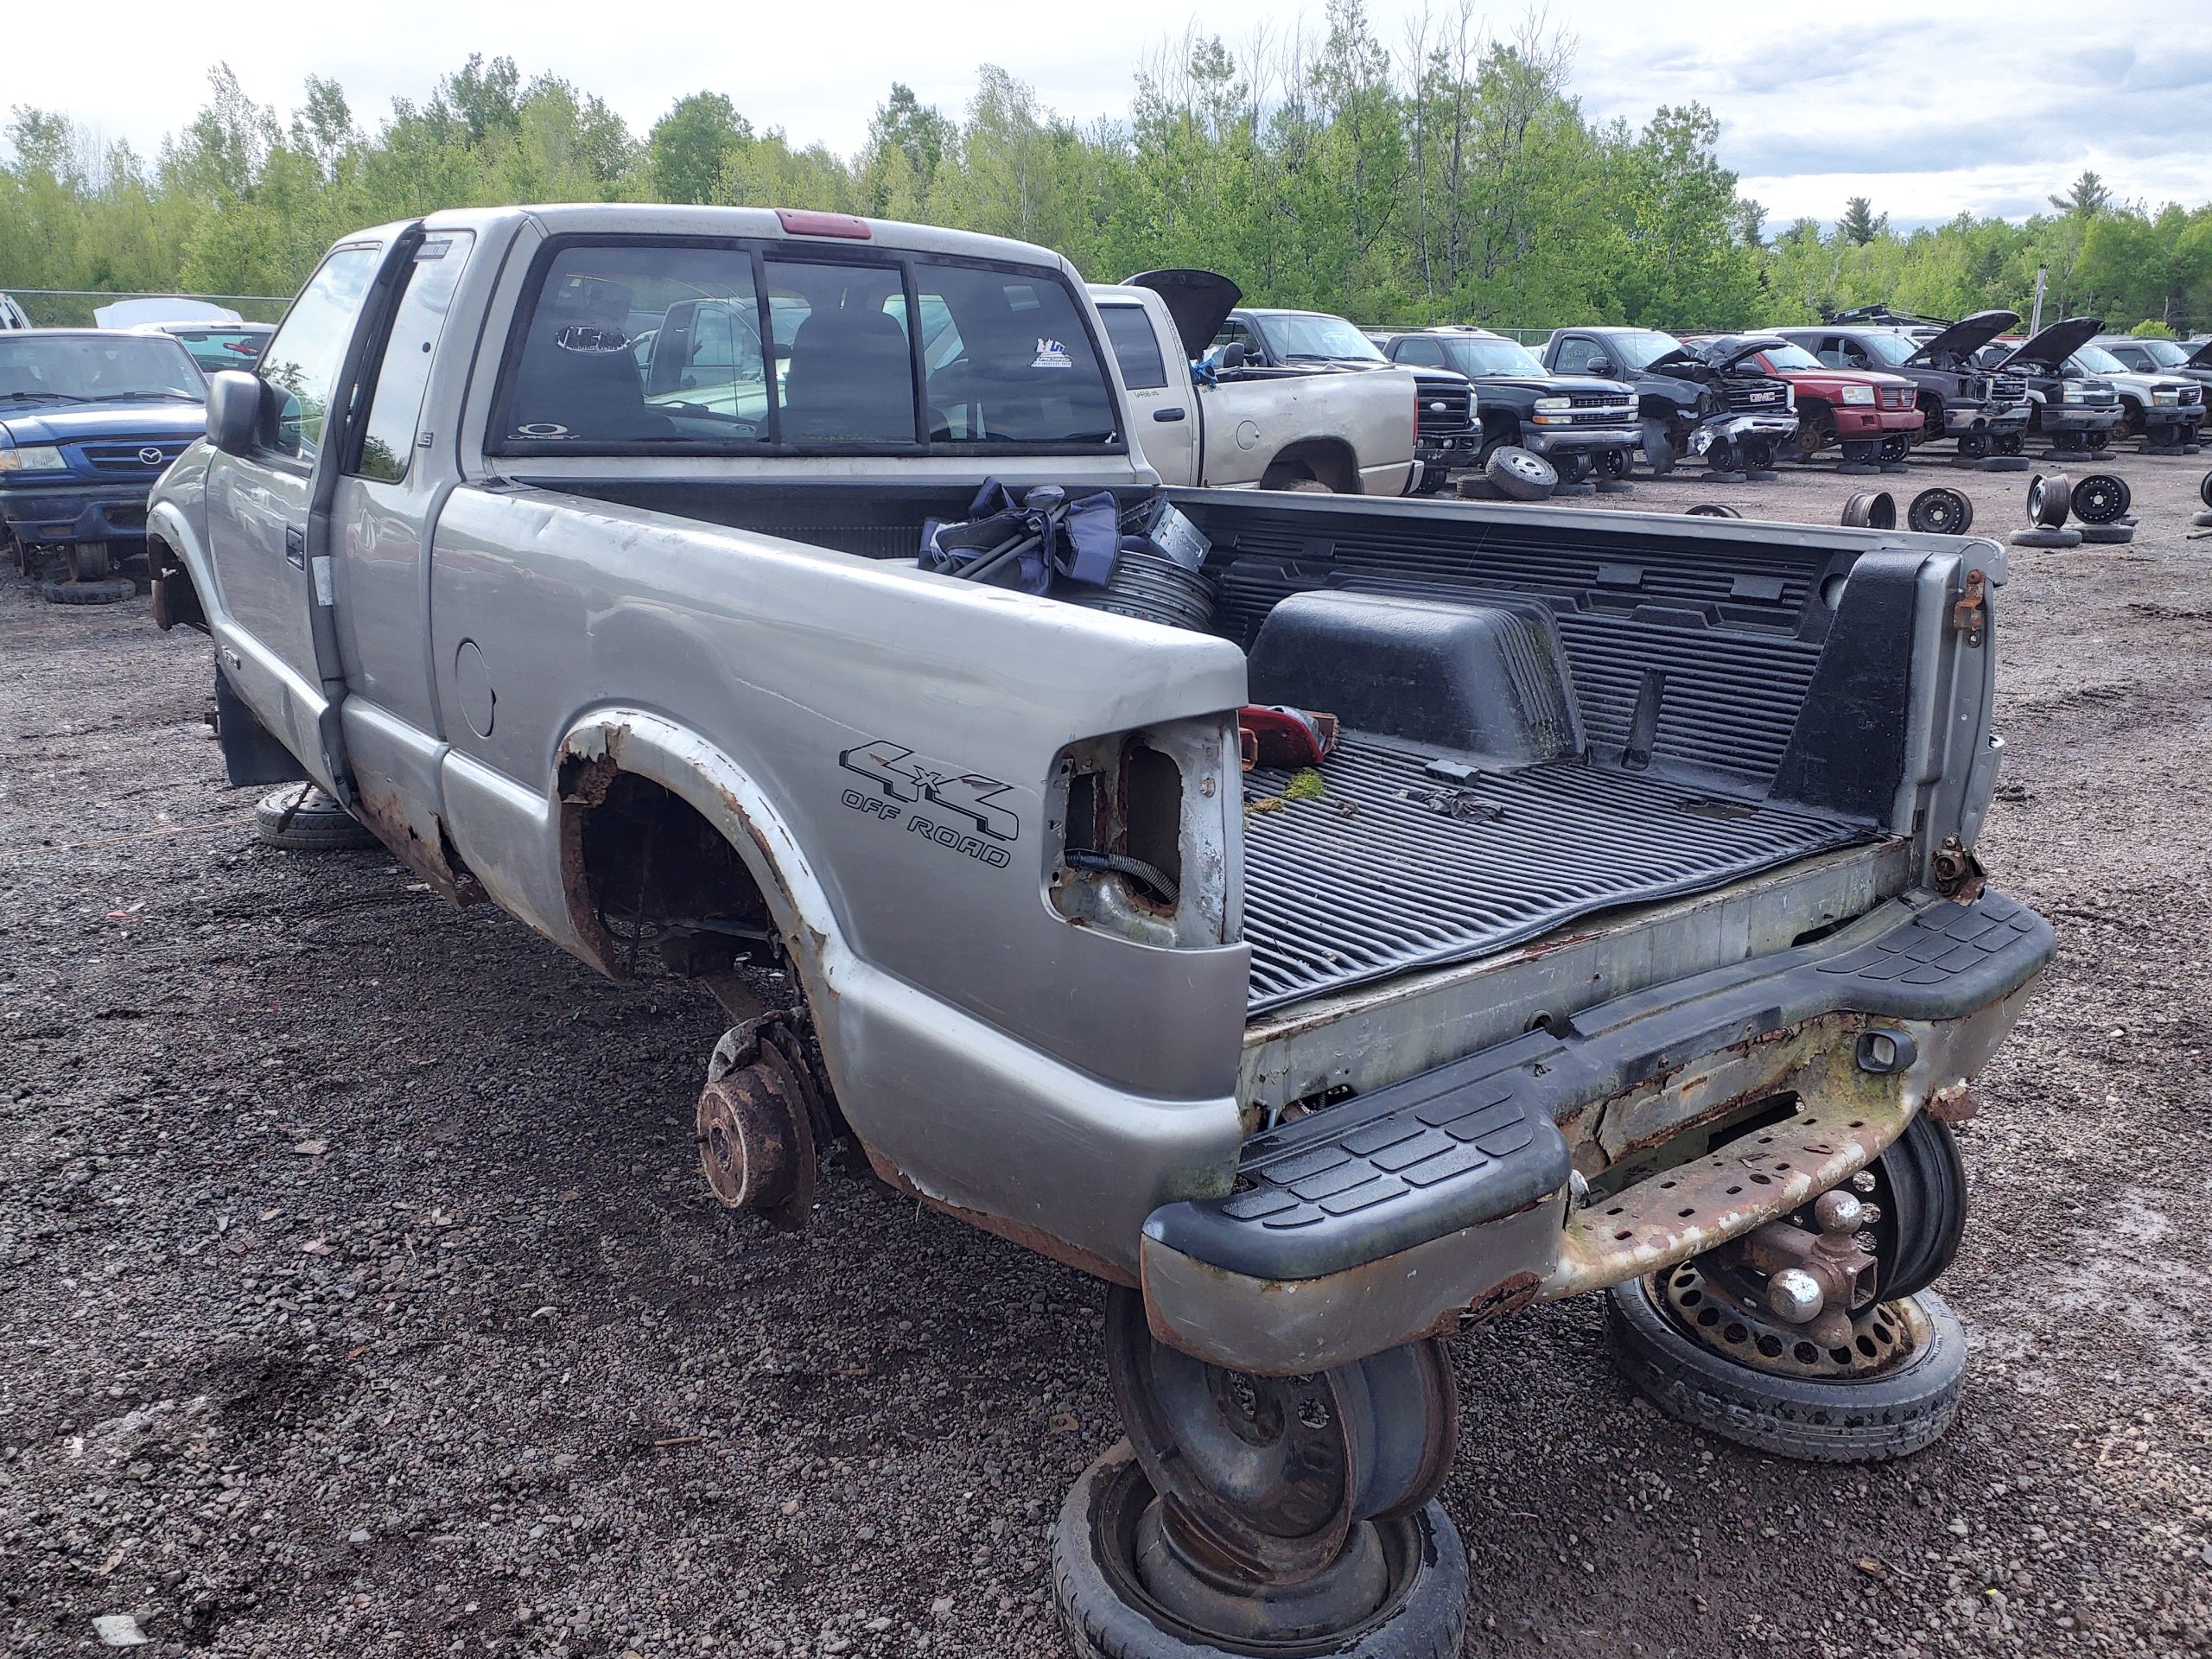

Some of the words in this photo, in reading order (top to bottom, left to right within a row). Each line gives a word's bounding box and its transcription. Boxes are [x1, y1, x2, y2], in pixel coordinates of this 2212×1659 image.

[1750, 391, 1776, 403] GMC
[842, 789, 900, 820] OFF
[907, 816, 1011, 868] ROAD
